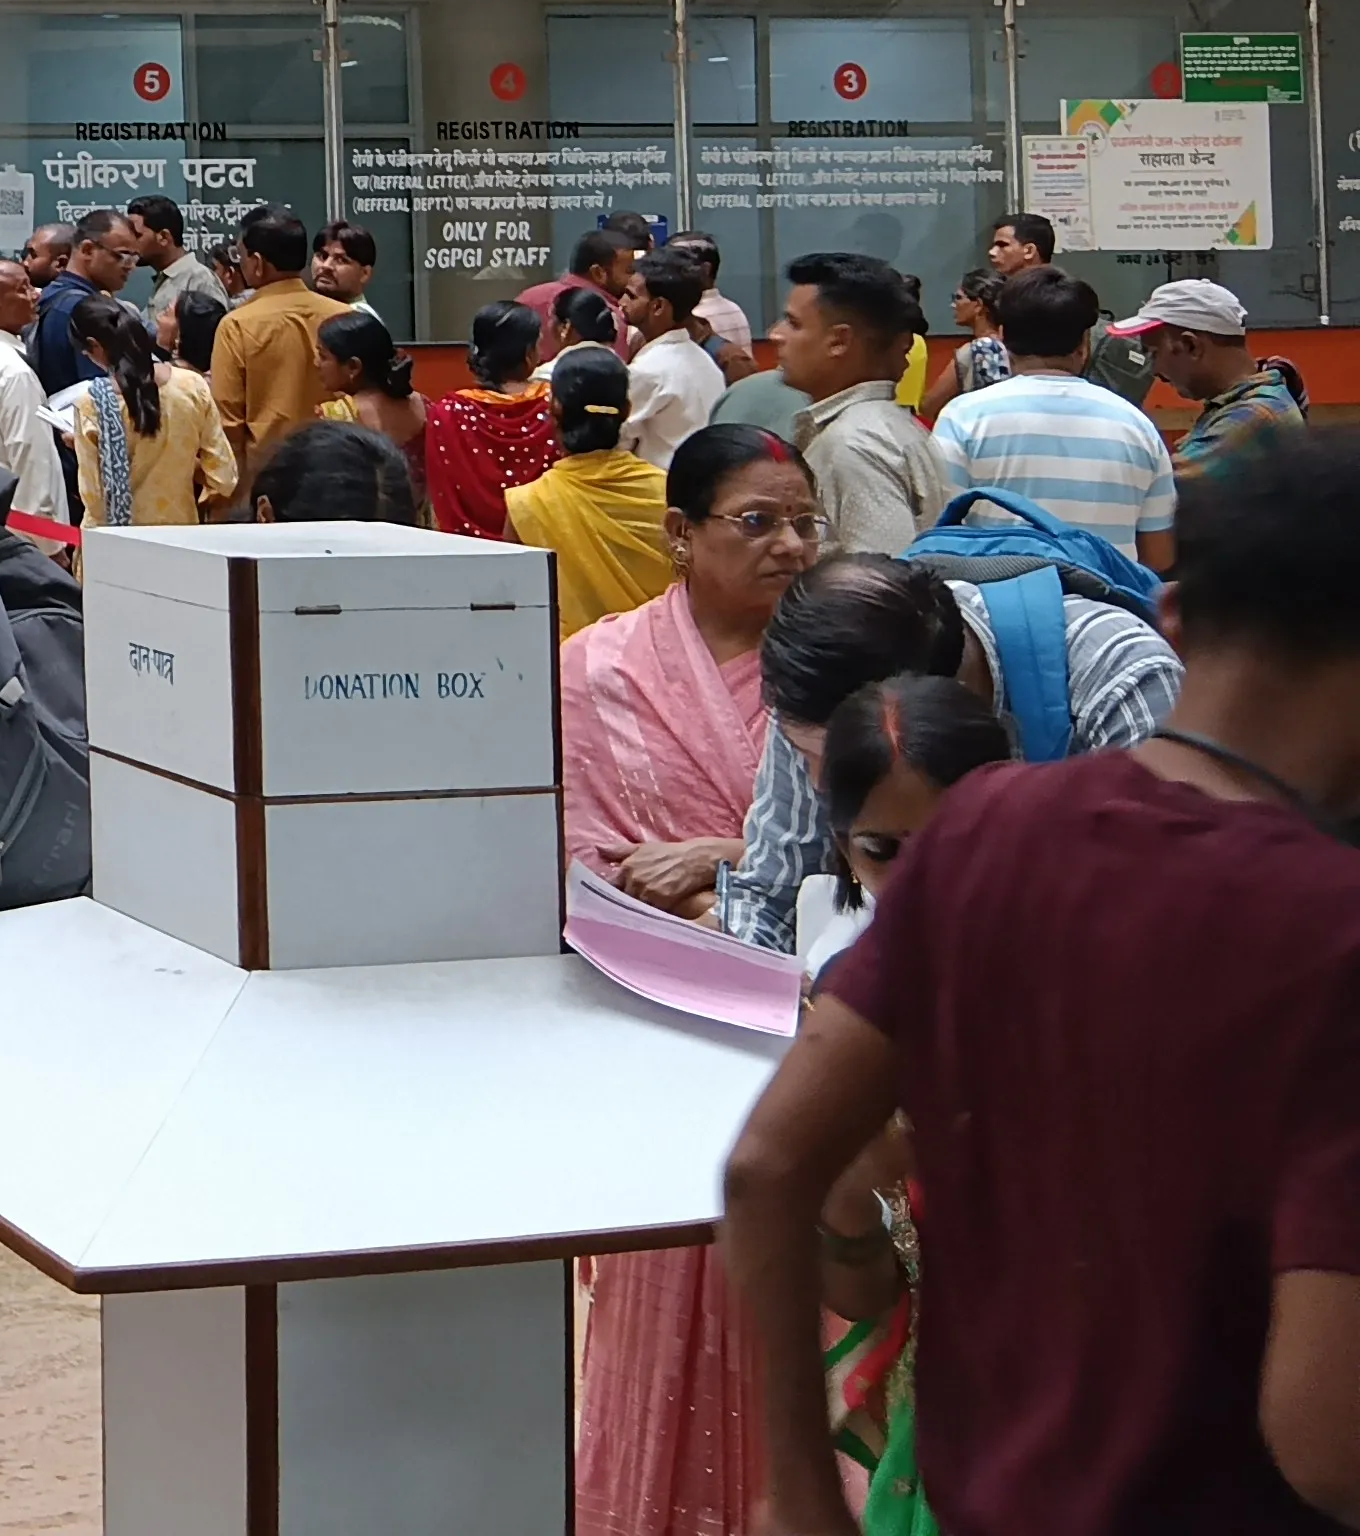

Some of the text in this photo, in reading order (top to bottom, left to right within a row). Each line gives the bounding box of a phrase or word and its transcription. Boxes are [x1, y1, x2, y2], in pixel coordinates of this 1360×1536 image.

[144, 70, 160, 93] 5
[500, 71, 516, 92] 4
[843, 70, 858, 92] 3
[75, 122, 227, 142] REGISTRATION
[437, 121, 580, 140] REGISTRATION
[788, 120, 909, 138] REGISTRATION
[42, 151, 257, 189] पंजीकरण पटल
[442, 221, 531, 242] ONLY FOR
[424, 247, 551, 268] SGPGI STAFF
[305, 672, 485, 701] DONATION BOX
